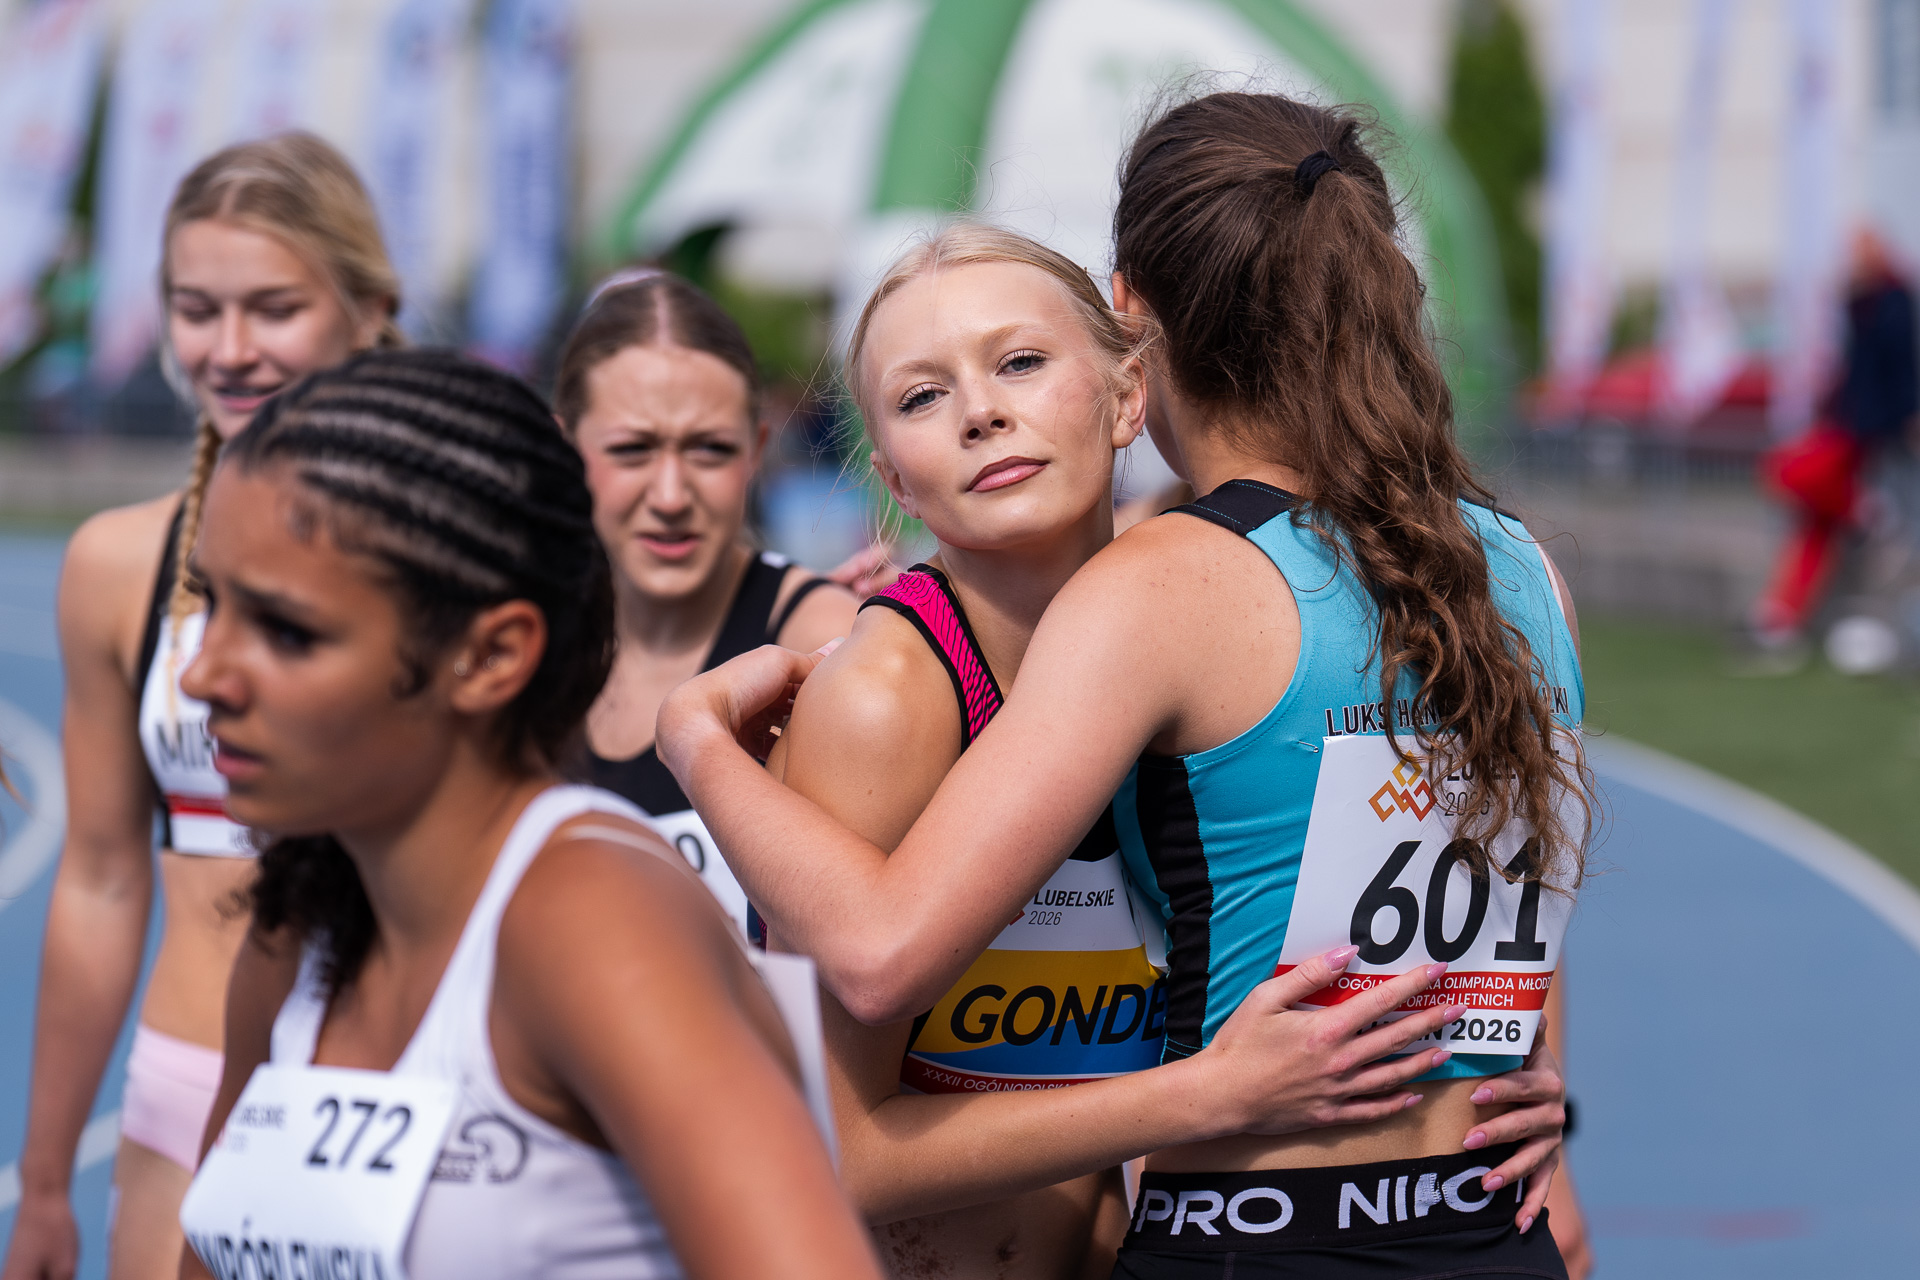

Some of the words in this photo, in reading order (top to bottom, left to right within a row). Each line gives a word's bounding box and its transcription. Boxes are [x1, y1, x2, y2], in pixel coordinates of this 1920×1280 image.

[1033, 888, 1115, 908] LUBELSKIE
[1349, 837, 1548, 966] 601
[1028, 910, 1063, 926] 2026
[1444, 976, 1515, 990] OLIMPIADA
[1457, 992, 1515, 1007] LETNICH
[1450, 1018, 1522, 1043] 2026
[922, 1067, 962, 1087] XXXII
[307, 1097, 412, 1172] 272
[1134, 1187, 1294, 1236] PRO
